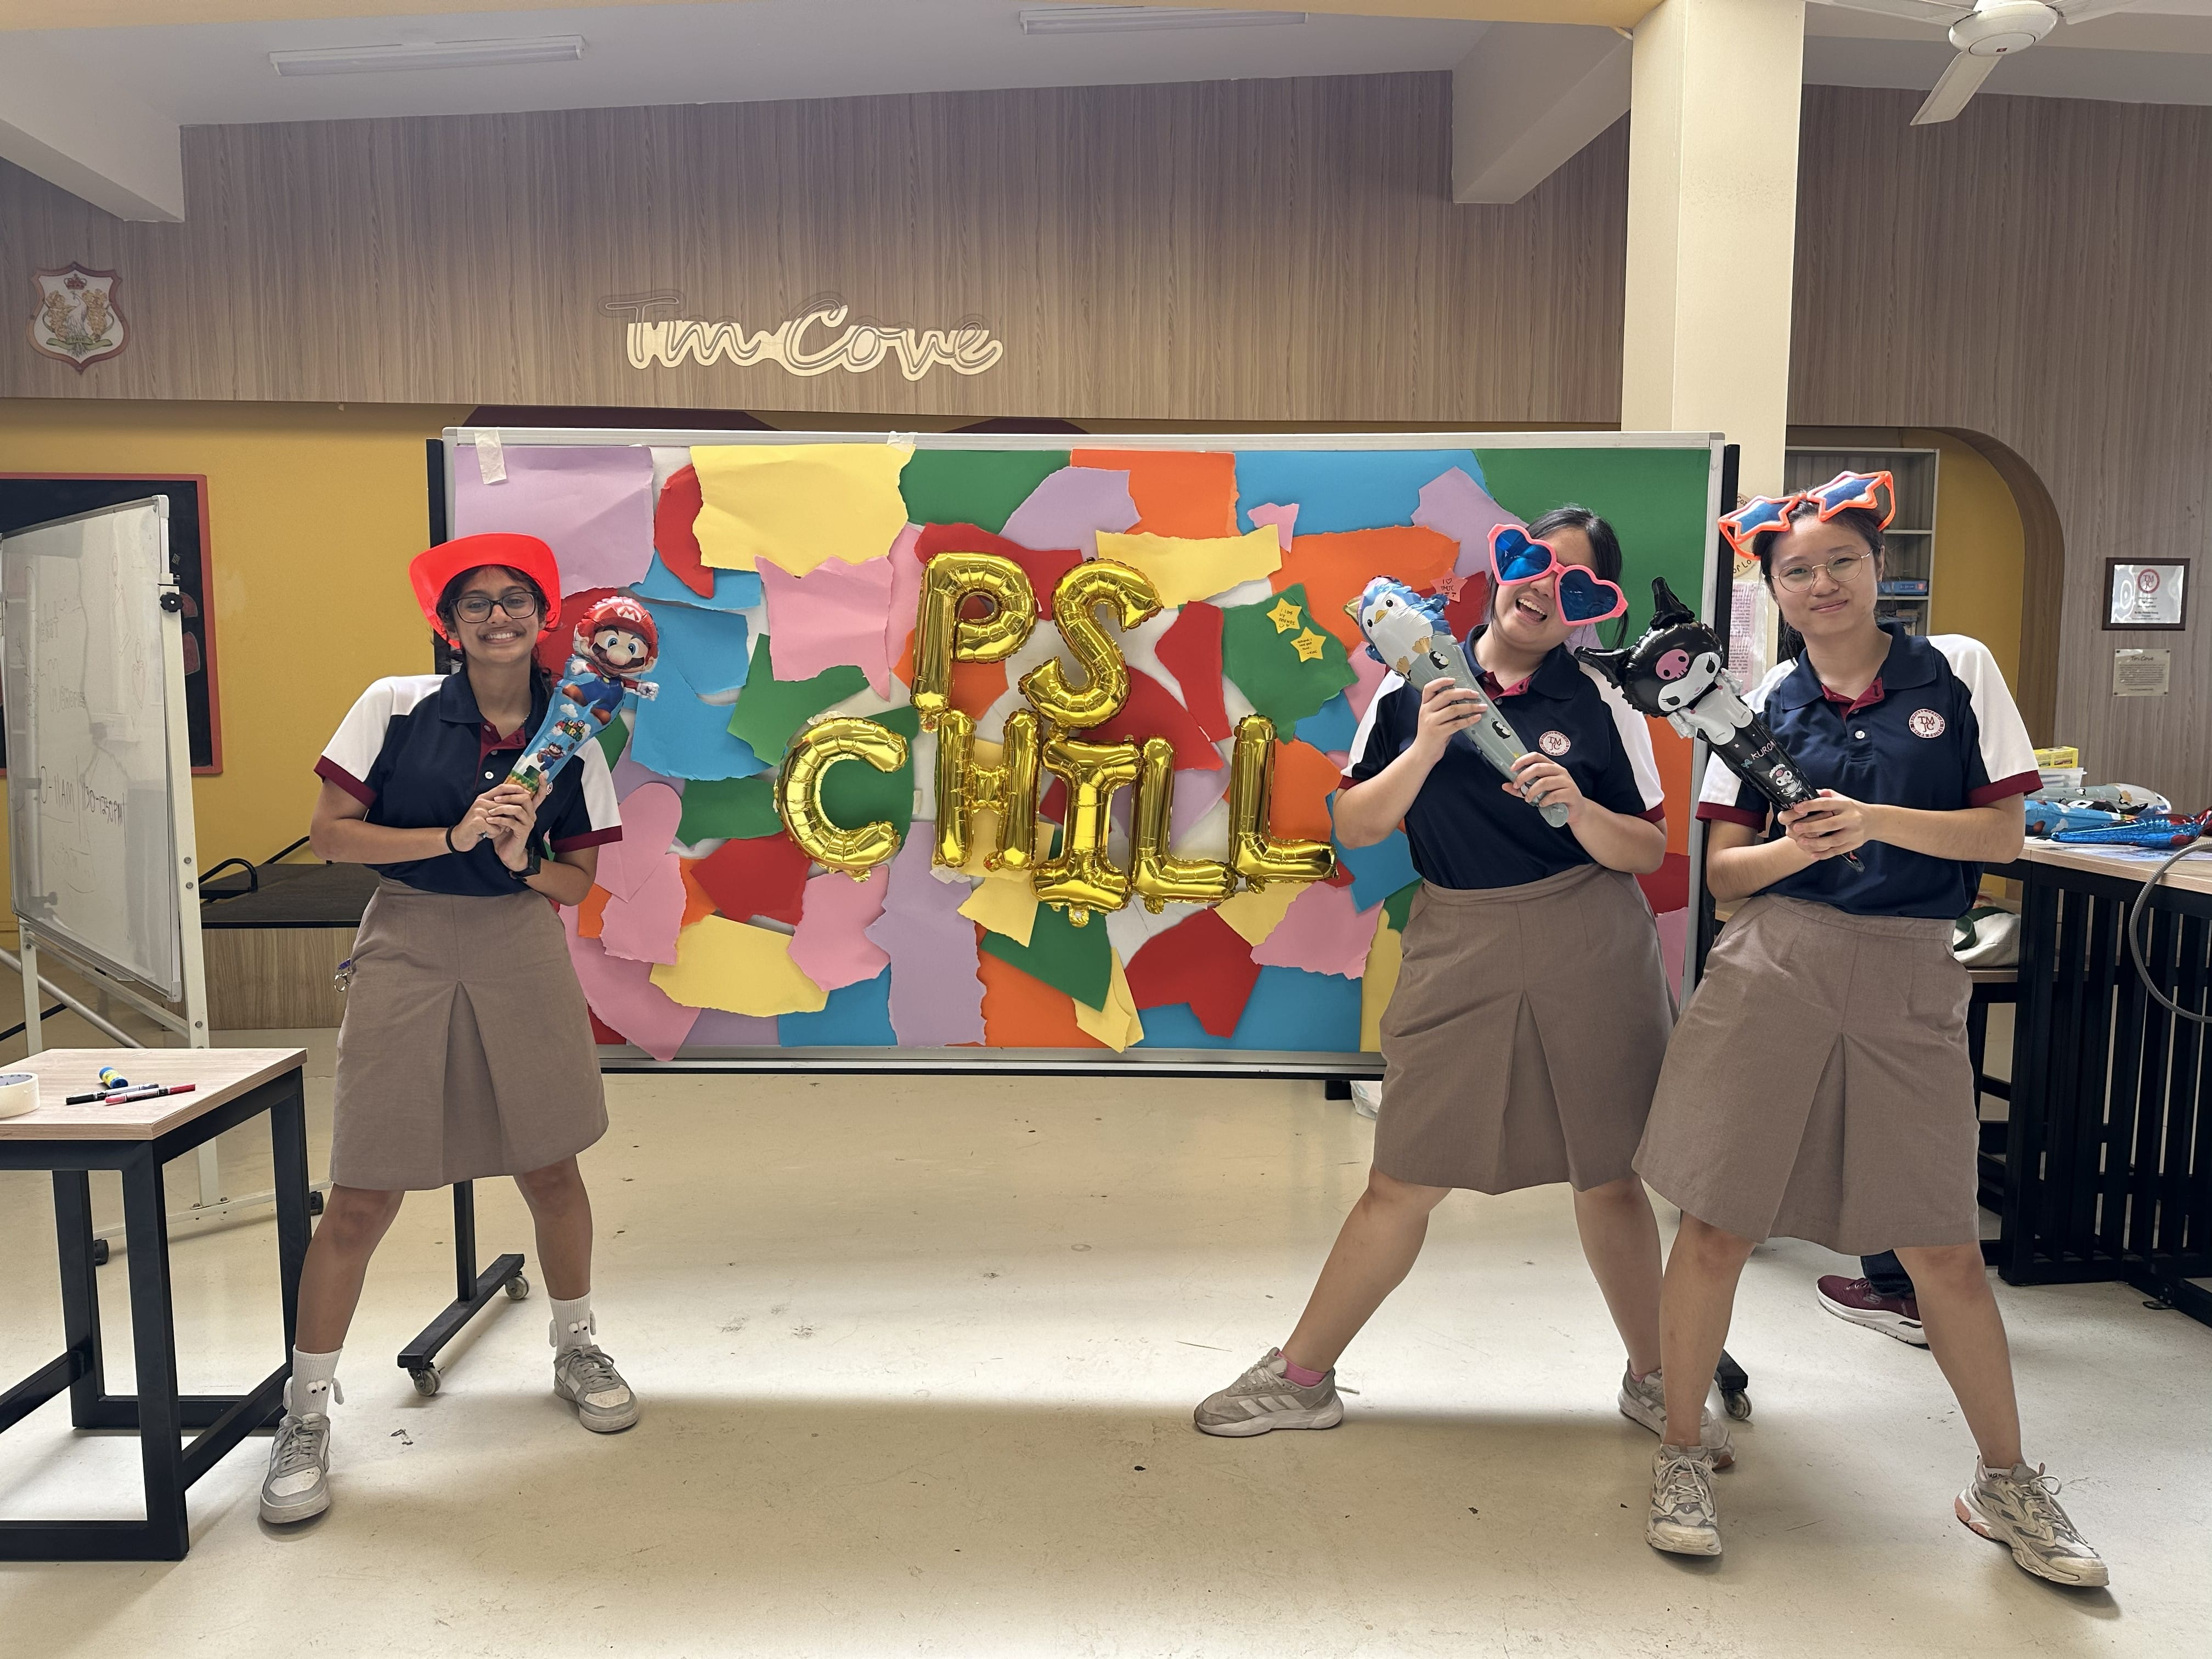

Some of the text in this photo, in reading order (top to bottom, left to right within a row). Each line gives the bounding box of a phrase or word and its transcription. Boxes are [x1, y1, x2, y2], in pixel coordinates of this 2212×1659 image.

[779, 292, 1003, 381] Cove
[1736, 496, 1747, 506] Coz
[1741, 560, 1752, 568] Lo
[2145, 580, 2152, 589] JC
[619, 606, 639, 620] M
[911, 551, 1164, 734] PS
[1918, 716, 1936, 724] TM
[563, 717, 585, 734] SUPER
[1922, 723, 1934, 732] JC
[555, 720, 583, 742] MARIO
[1547, 736, 1562, 745] TM
[1549, 742, 1560, 751] JC
[774, 708, 1339, 917] CHILL
